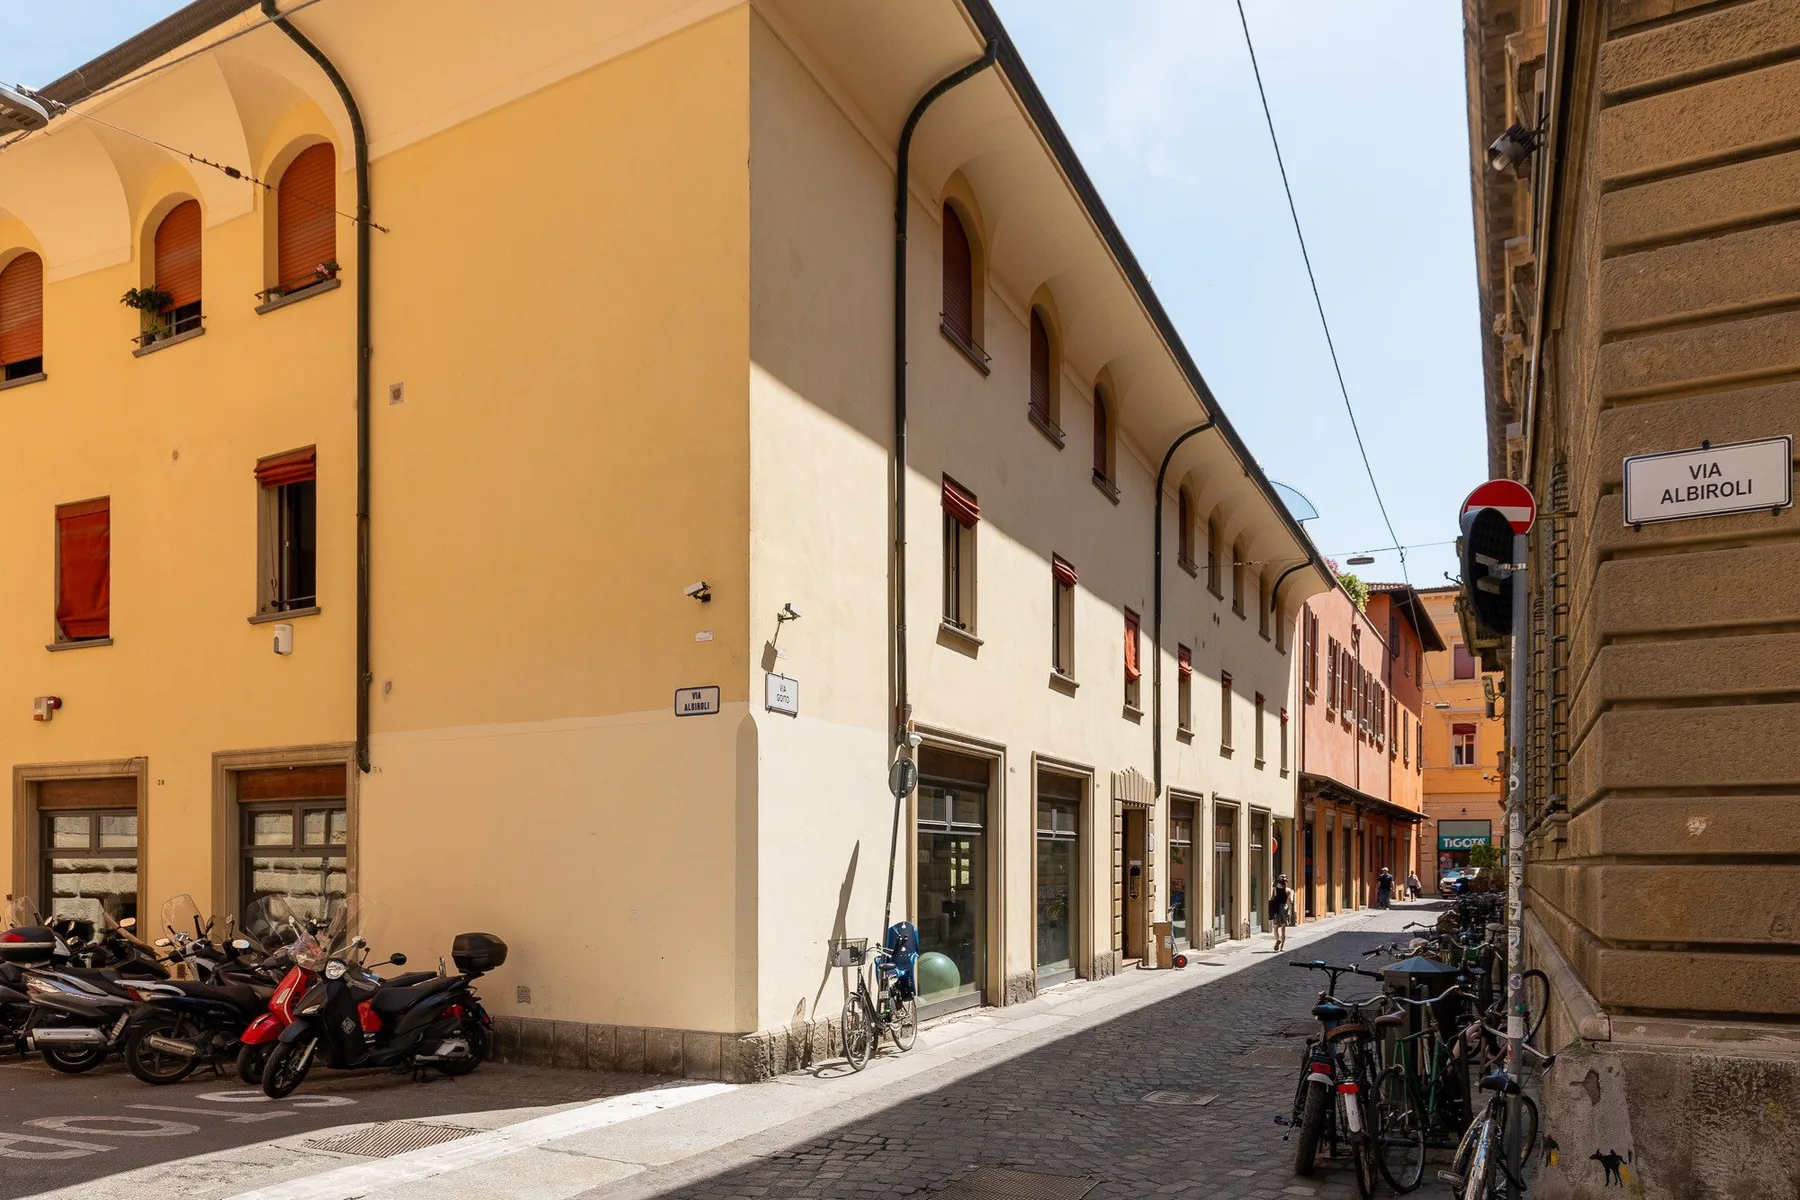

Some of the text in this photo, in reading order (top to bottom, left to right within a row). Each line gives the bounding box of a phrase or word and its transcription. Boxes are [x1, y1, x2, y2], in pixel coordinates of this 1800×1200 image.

[1688, 462, 1722, 480] VIA
[1660, 479, 1752, 504] ALBIROLI
[779, 684, 787, 693] VIA
[691, 691, 702, 700] VIA
[684, 702, 710, 711] ALBIROLI
